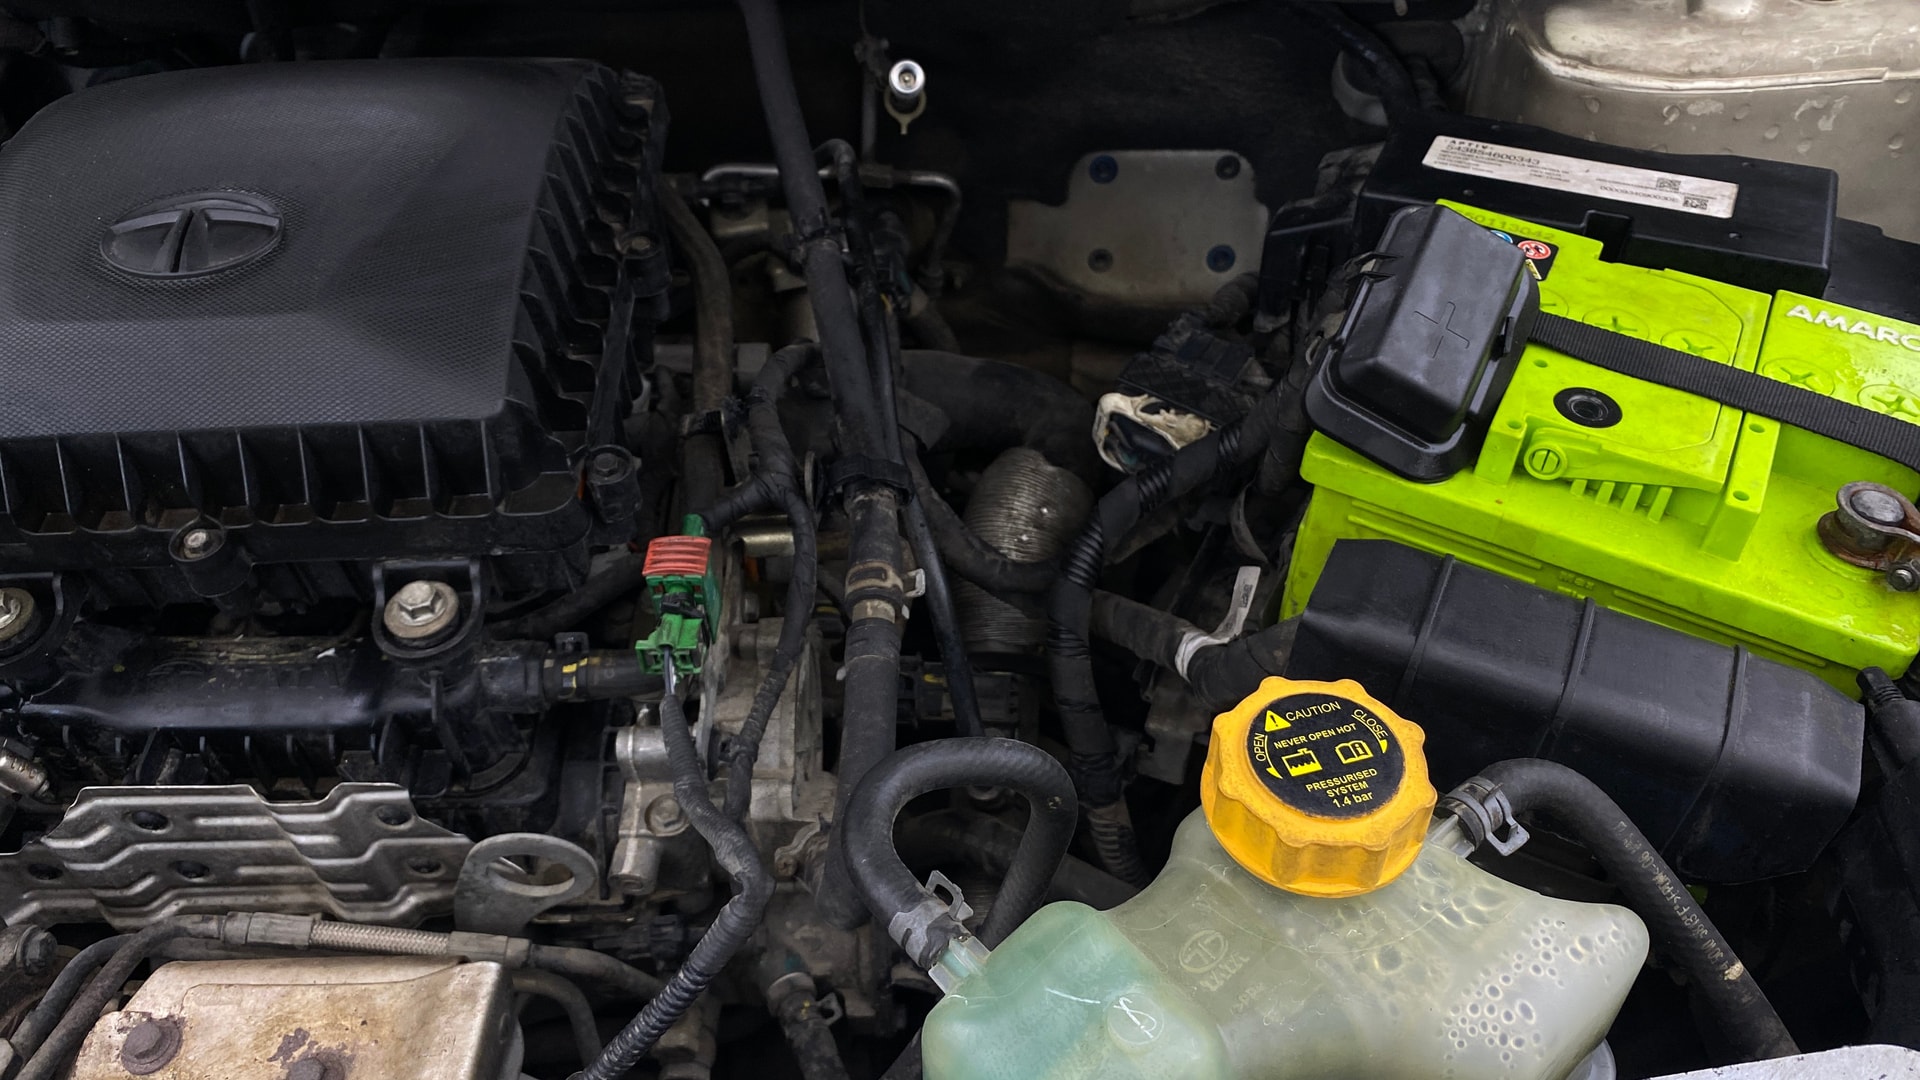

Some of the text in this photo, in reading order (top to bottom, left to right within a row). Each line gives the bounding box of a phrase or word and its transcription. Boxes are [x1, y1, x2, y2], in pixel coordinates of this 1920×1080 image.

[1285, 701, 1341, 722] CAUTION
[1273, 722, 1357, 749] NEVER OPEN HOT
[1353, 709, 1389, 740] CLOSE
[1254, 732, 1266, 762] OPEN
[1305, 768, 1378, 792] PRESSURISED
[1326, 781, 1369, 798] SYSTEM
[1332, 791, 1374, 809] 1.4 bar
